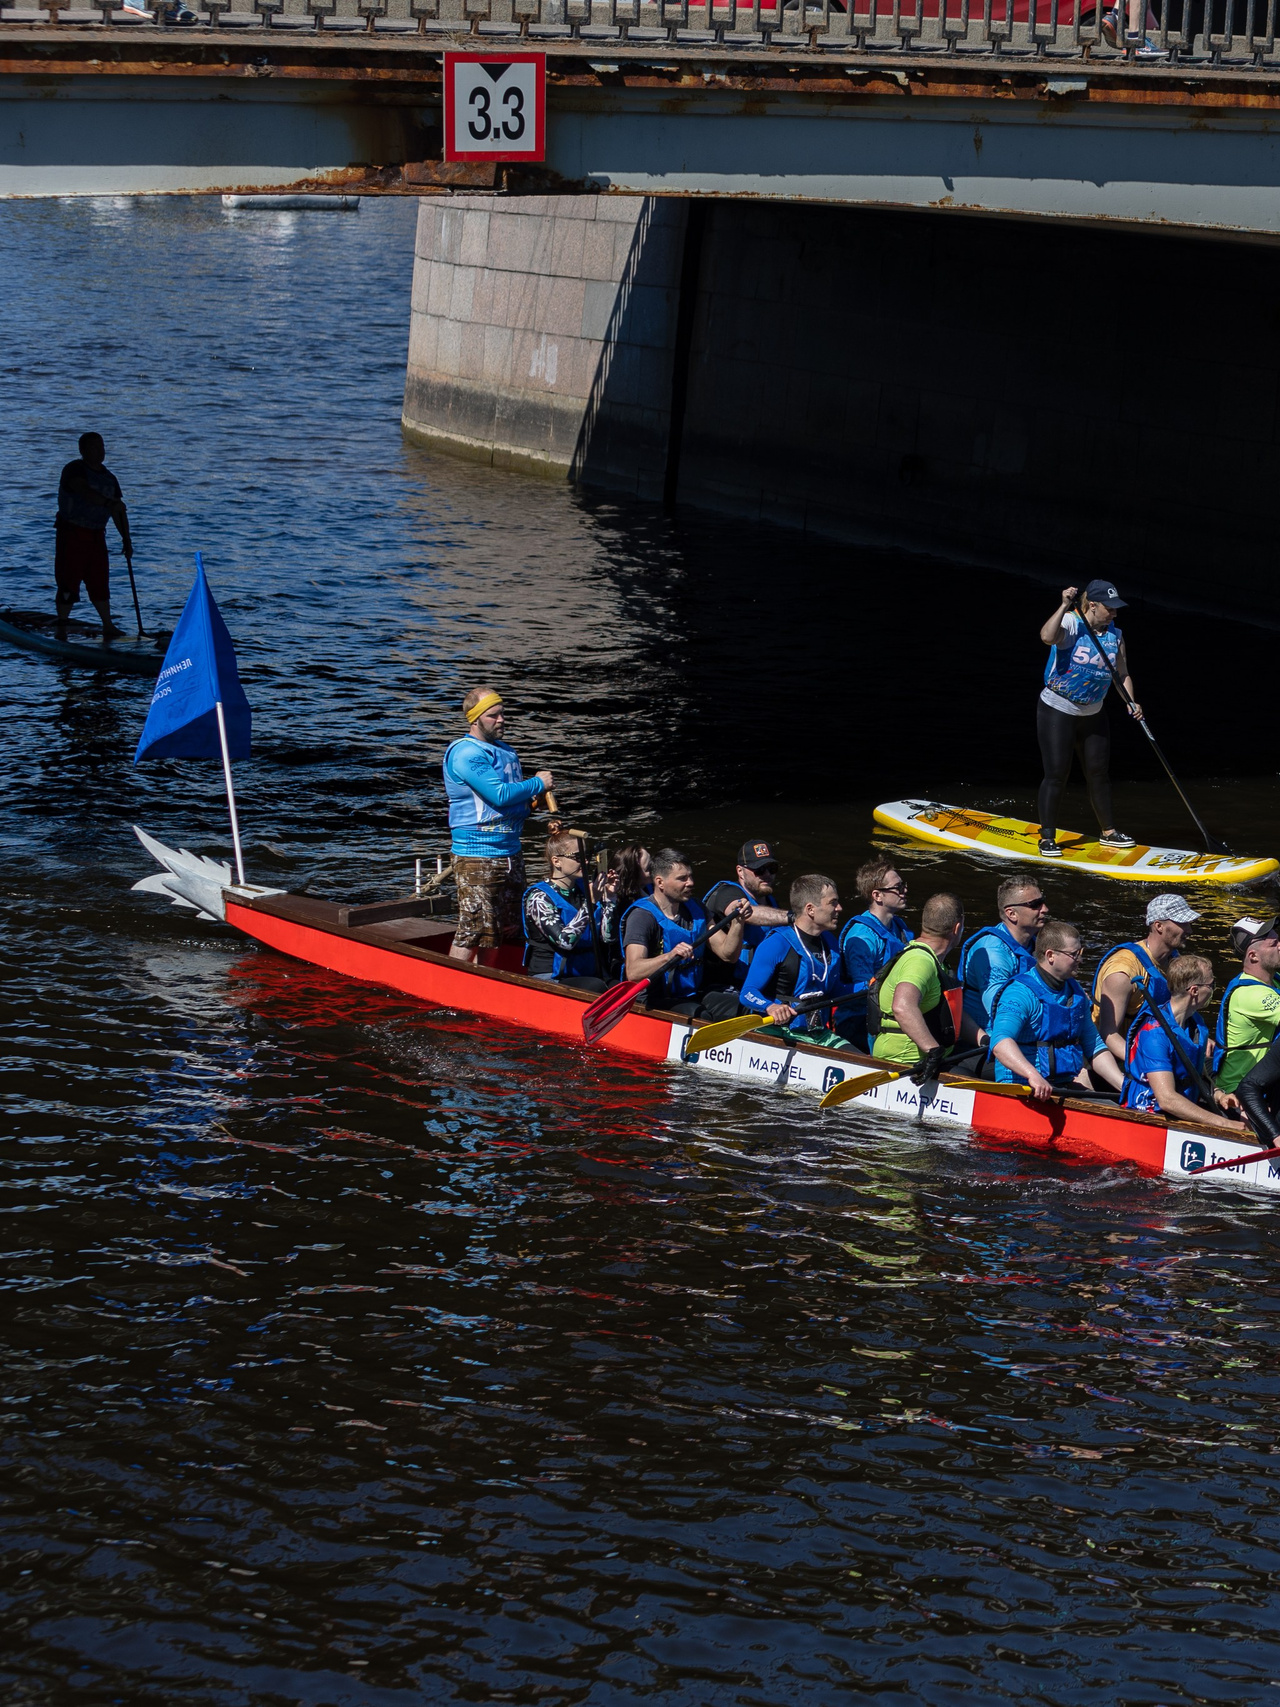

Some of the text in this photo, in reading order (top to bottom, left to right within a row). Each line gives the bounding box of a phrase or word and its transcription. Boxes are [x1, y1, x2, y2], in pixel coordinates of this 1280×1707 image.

[468, 86, 525, 141] 3.3
[749, 1057, 806, 1080] MARVEL
[896, 1090, 958, 1115] MARVEL
